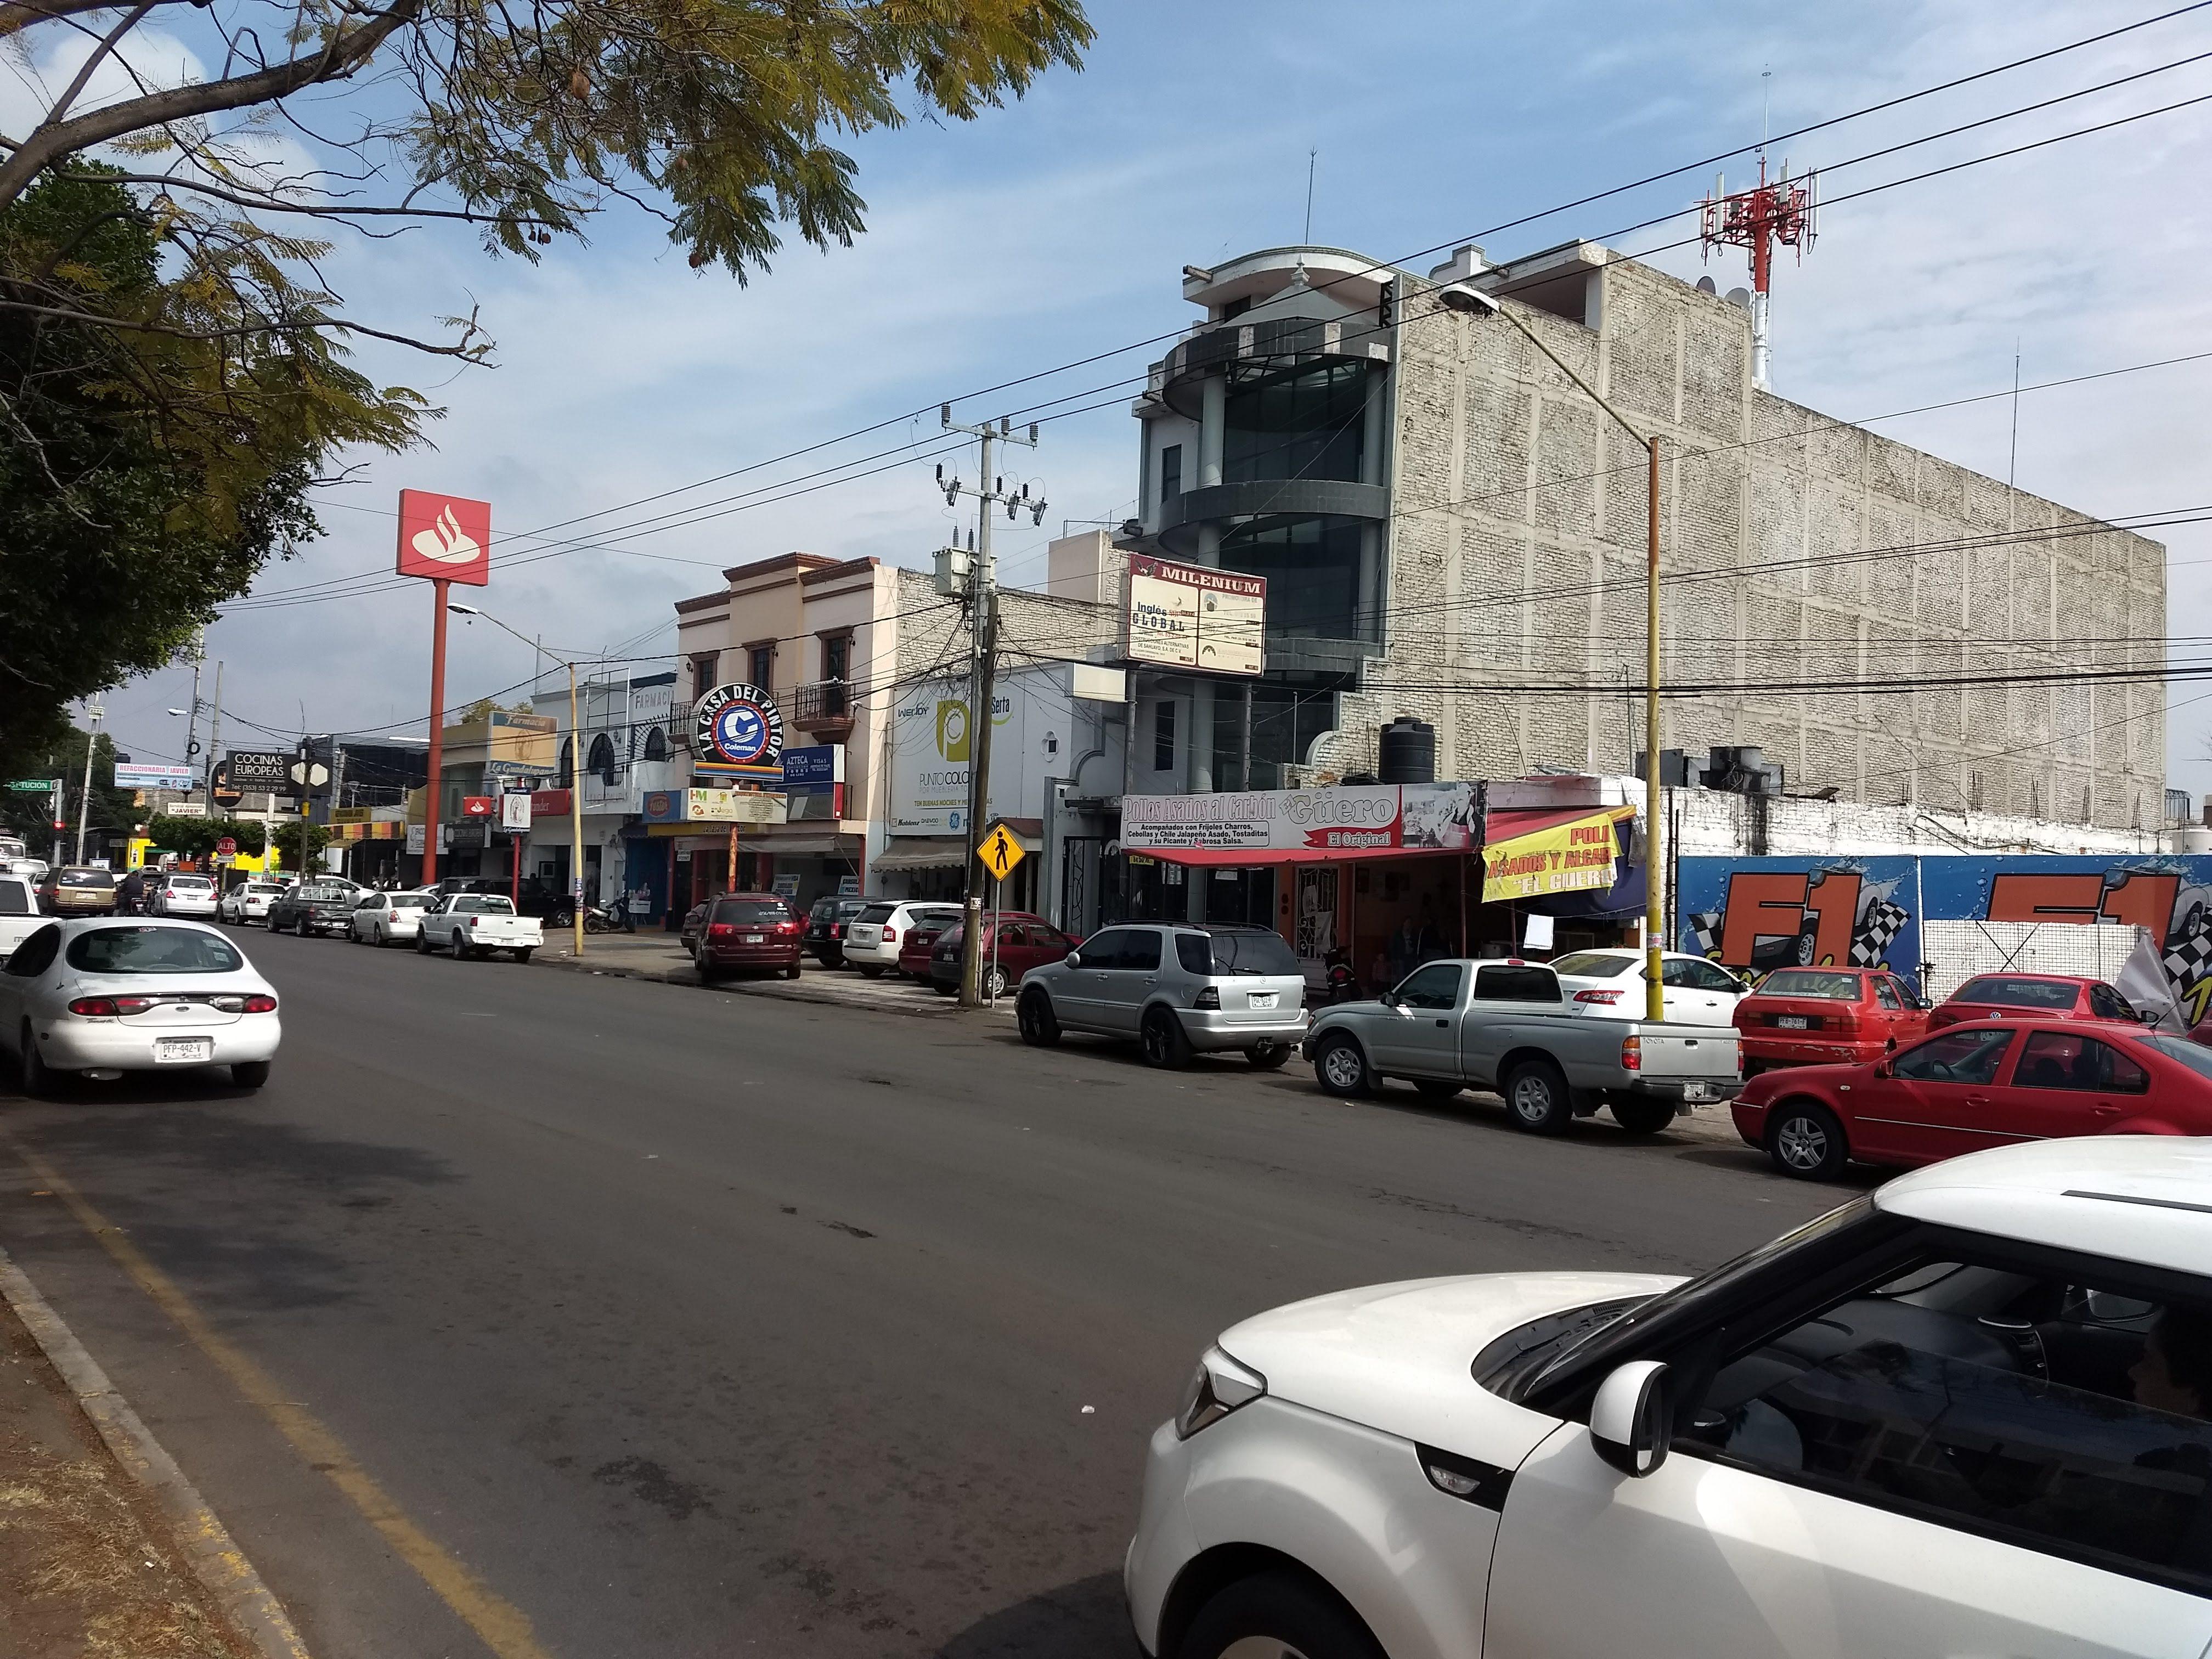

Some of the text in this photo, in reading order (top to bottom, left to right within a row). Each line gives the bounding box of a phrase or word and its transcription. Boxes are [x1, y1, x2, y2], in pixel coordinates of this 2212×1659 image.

[1161, 566, 1261, 594] MILENIUM
[1138, 601, 1167, 616] Inglés
[1131, 636, 1164, 645] CONSTRUCCIONES
[1164, 641, 1189, 649] ALTERNATIVAS
[635, 691, 675, 709] FARMACIA
[992, 696, 1010, 714] Serta
[505, 714, 545, 726] Farmacia
[698, 686, 783, 758] LA CASA DEL PINTOR
[724, 743, 757, 752] Coleman
[235, 754, 283, 766] COCINAS
[787, 755, 808, 765] AZTECA
[120, 765, 166, 773] REFACCIONARIA
[235, 764, 284, 776] EUROPEAS
[490, 763, 555, 776] La Guadalupana
[919, 771, 969, 786] PUNTO COLC
[690, 790, 707, 801] HM
[1124, 793, 1276, 821] Pollos Asados al Carbón
[1288, 792, 1394, 825] Güero
[1177, 831, 1206, 839] Jalapeño
[1328, 832, 1391, 847] El Original
[1488, 854, 1547, 879] ASADOS
[1550, 852, 1561, 870] Y
[1719, 872, 1862, 967] F1
[163, 1044, 201, 1053] PFP-442-V
